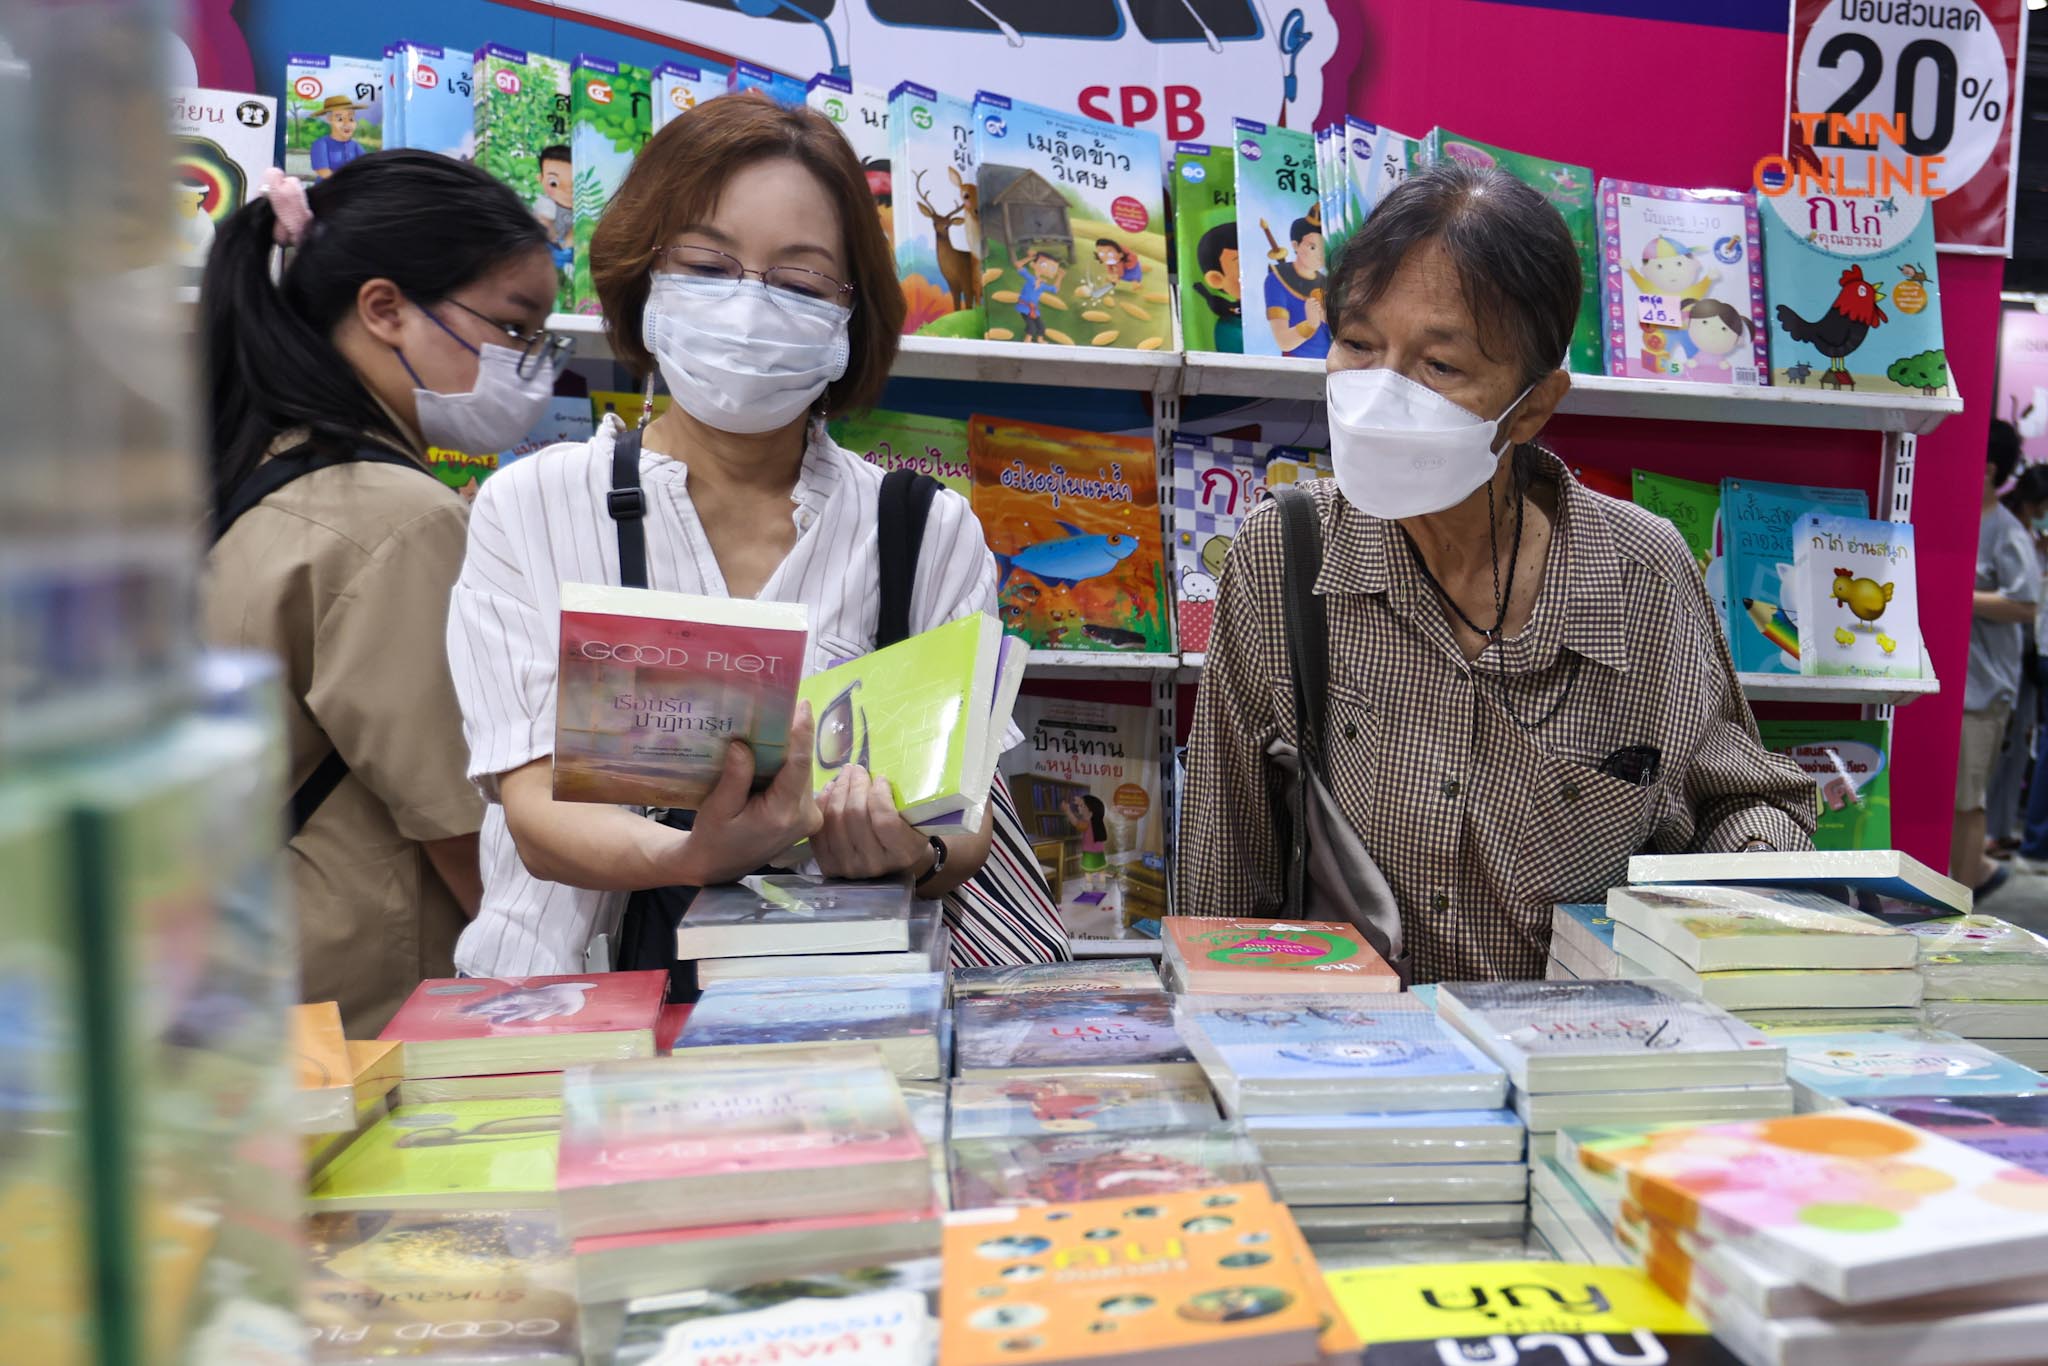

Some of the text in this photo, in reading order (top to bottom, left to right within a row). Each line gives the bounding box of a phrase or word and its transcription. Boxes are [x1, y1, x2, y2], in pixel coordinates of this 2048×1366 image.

[1840, 0, 1981, 32] มอบสวนลด
[1078, 85, 1206, 142] SPB
[1027, 130, 1131, 172] เมล็ดข้าว
[1051, 154, 1109, 190] วิเศษ
[1000, 460, 1133, 509] อะไรอยู่ในแม่น้ำ
[581, 640, 783, 675] GOOD PLOT
